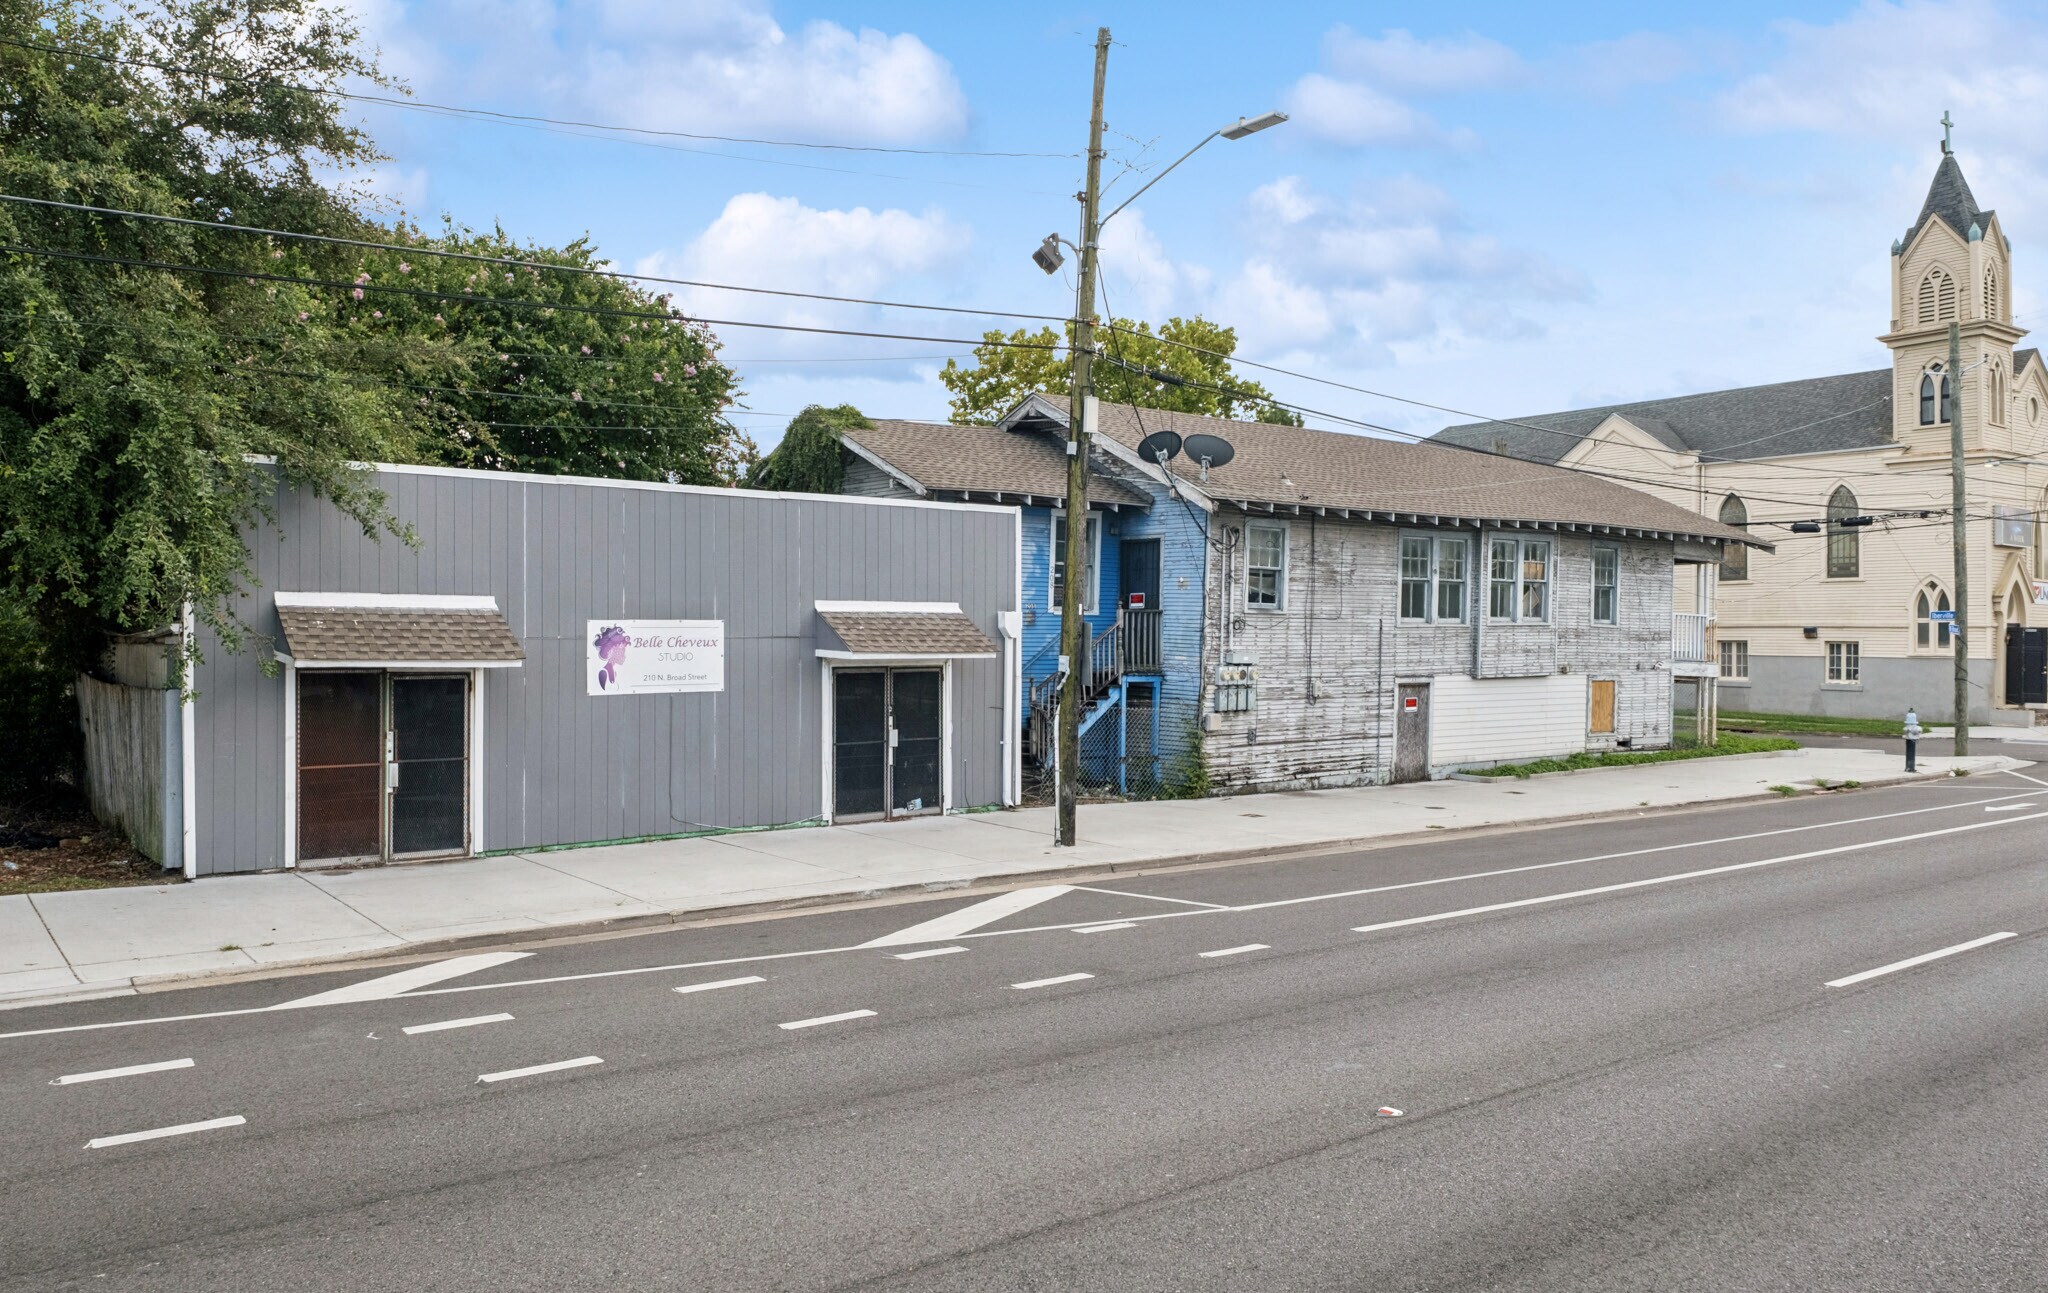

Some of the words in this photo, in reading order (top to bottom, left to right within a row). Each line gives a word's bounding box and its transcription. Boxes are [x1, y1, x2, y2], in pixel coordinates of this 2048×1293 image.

[633, 635, 663, 648] Belle
[667, 635, 719, 648] Cheveux
[657, 652, 694, 661] STUDIO
